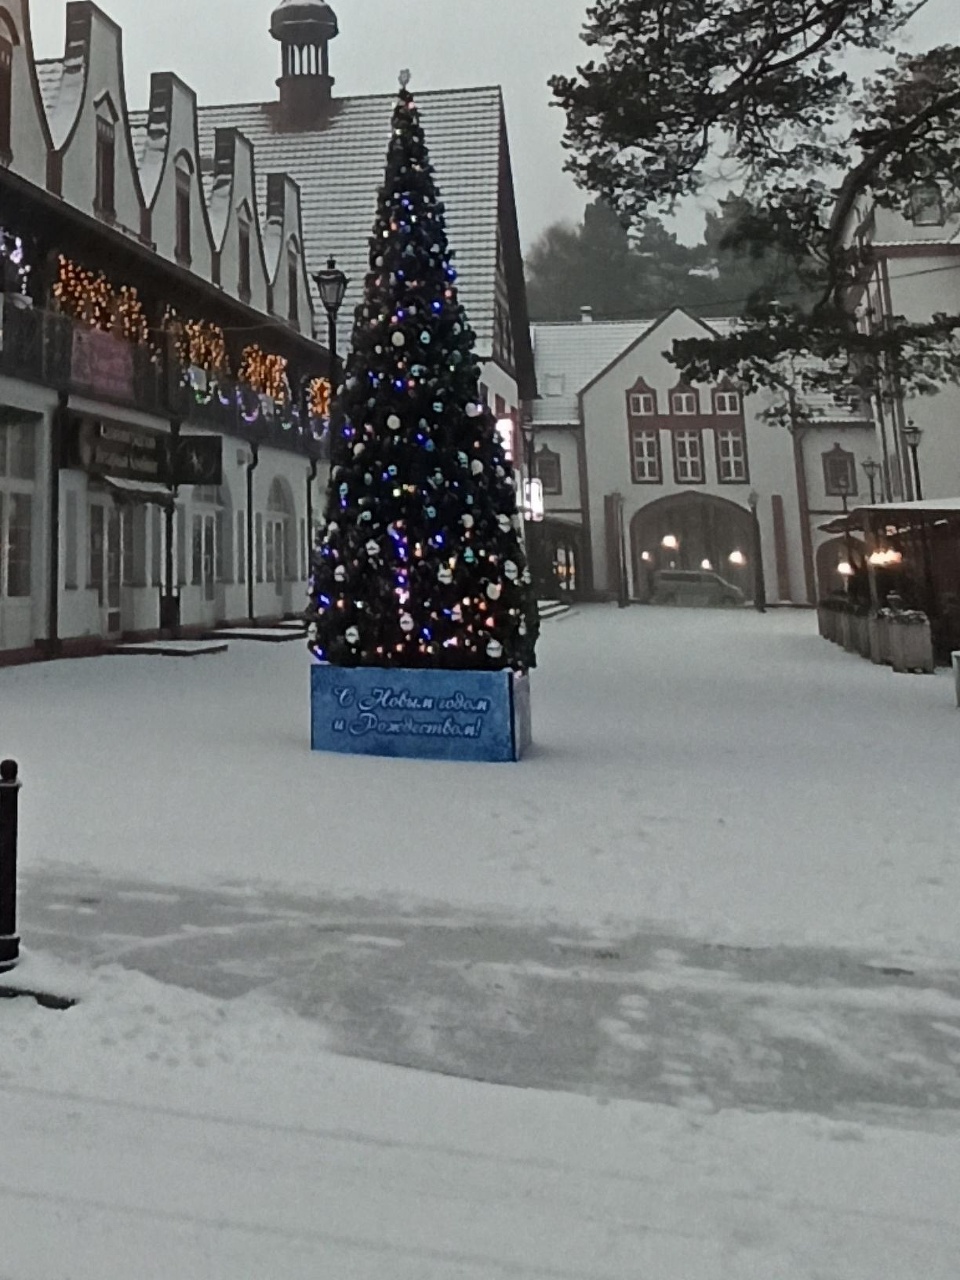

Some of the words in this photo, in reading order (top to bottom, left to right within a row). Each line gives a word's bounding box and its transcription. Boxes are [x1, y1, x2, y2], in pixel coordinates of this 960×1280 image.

[334, 687, 355, 707] С
[358, 688, 434, 711] Новым
[439, 692, 491, 712] годом
[334, 719, 344, 731] и
[349, 711, 482, 737] Рождеством!
